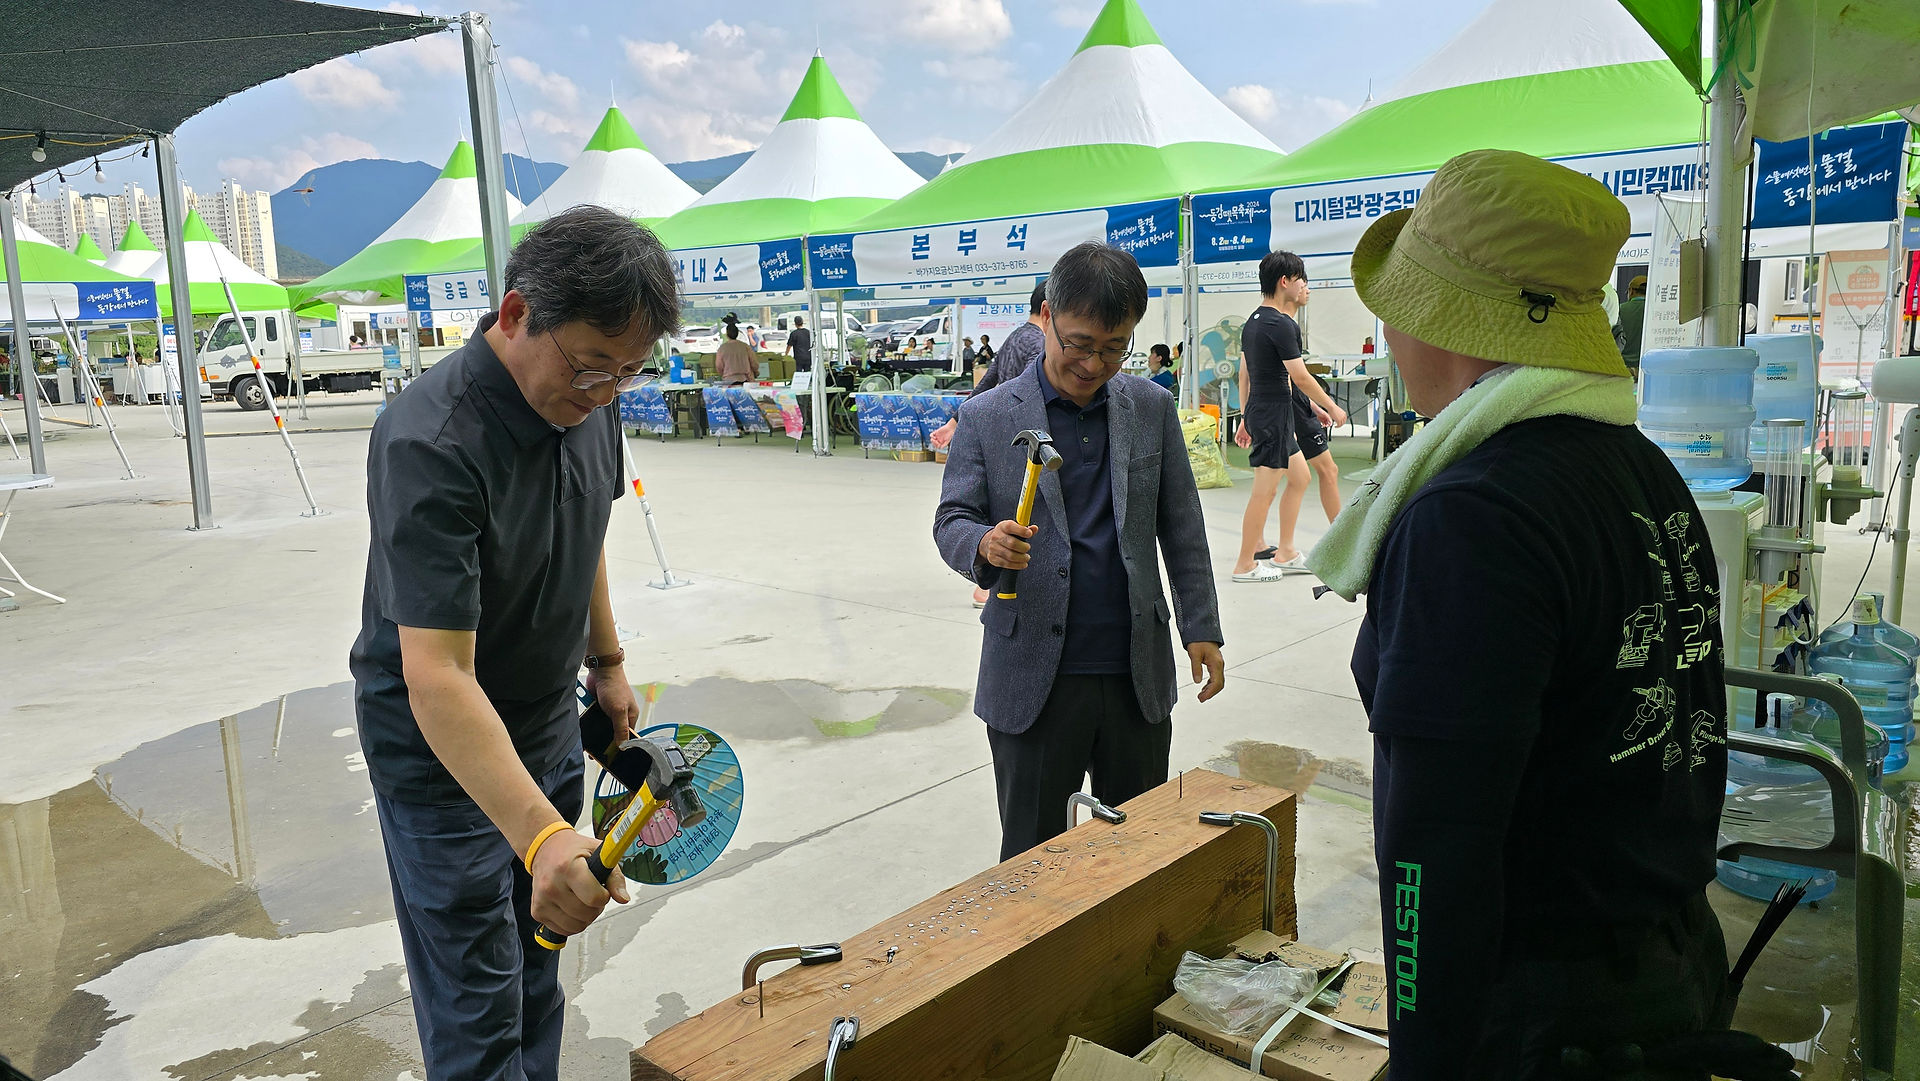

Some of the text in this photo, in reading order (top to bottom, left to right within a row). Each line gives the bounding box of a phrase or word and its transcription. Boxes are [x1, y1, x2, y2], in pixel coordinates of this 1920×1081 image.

[1783, 169, 1892, 207] 동강에서 만나다
[916, 260, 1028, 277] 바가지요금신고센터 033-373-8765
[1610, 741, 1647, 763] Hammer
[1395, 861, 1422, 1021] FESTOOL
